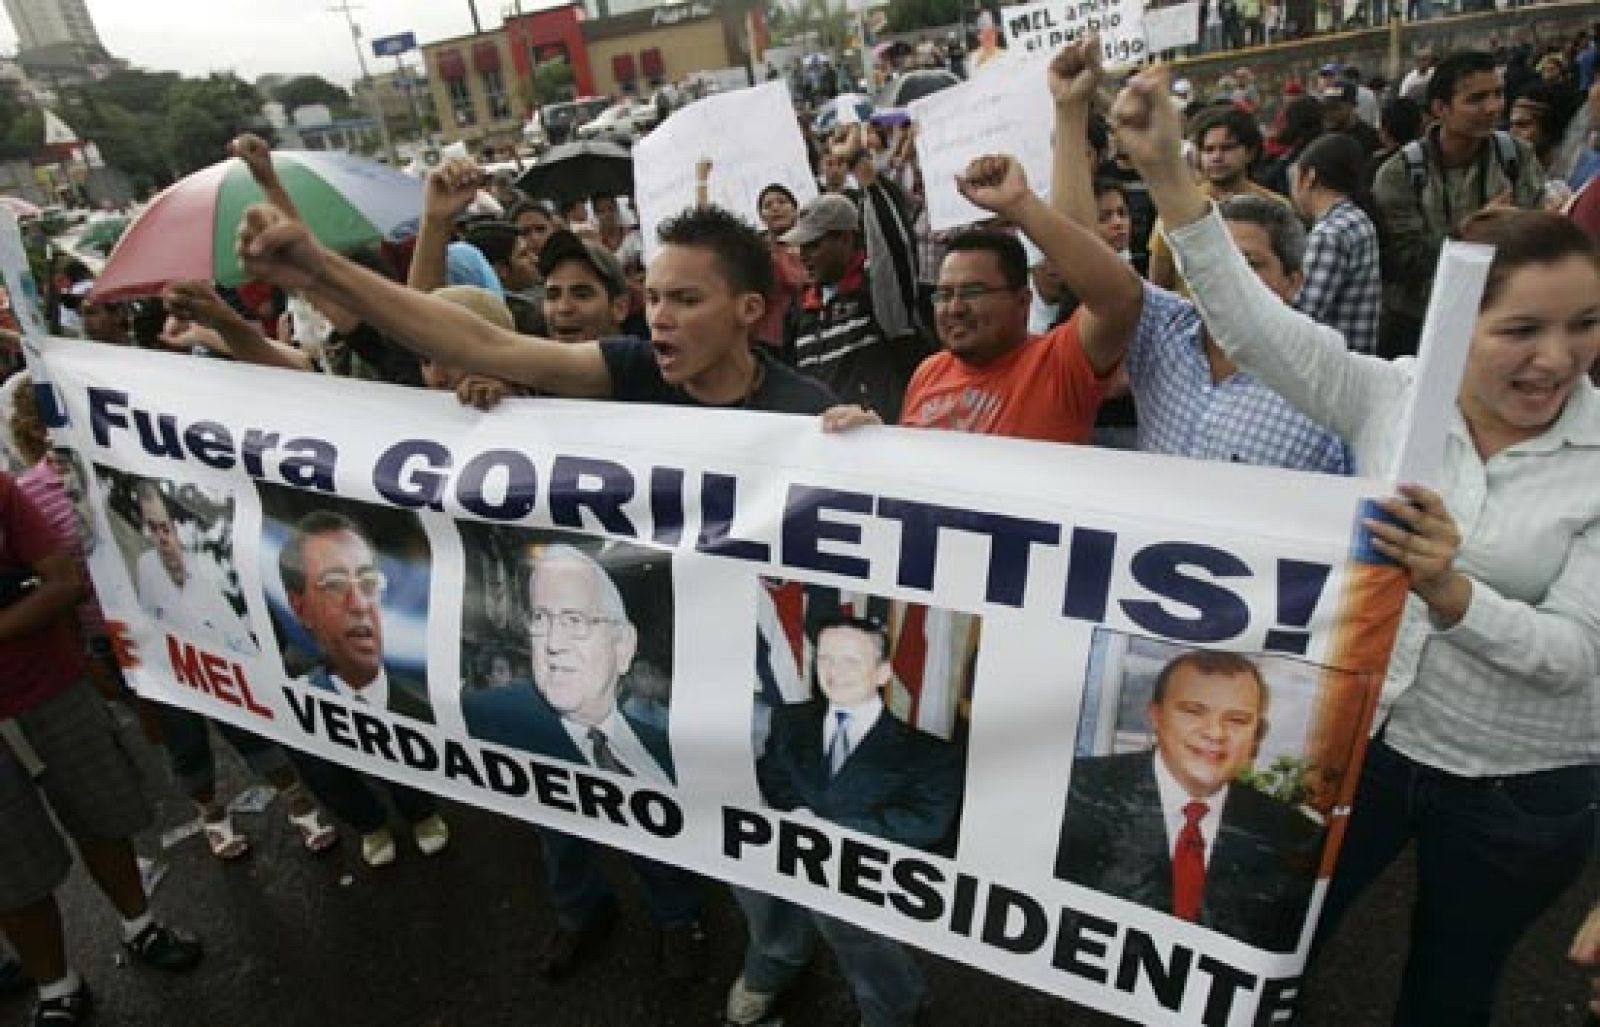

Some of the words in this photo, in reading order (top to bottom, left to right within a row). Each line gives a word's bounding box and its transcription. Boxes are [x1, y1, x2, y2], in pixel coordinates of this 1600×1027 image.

[87, 387, 337, 491] Fuera
[373, 438, 1332, 655] GORILETTIS!
[166, 632, 274, 718] MEL
[282, 685, 684, 838] VERDADERO
[721, 805, 1300, 1027] PRESIDENTE
